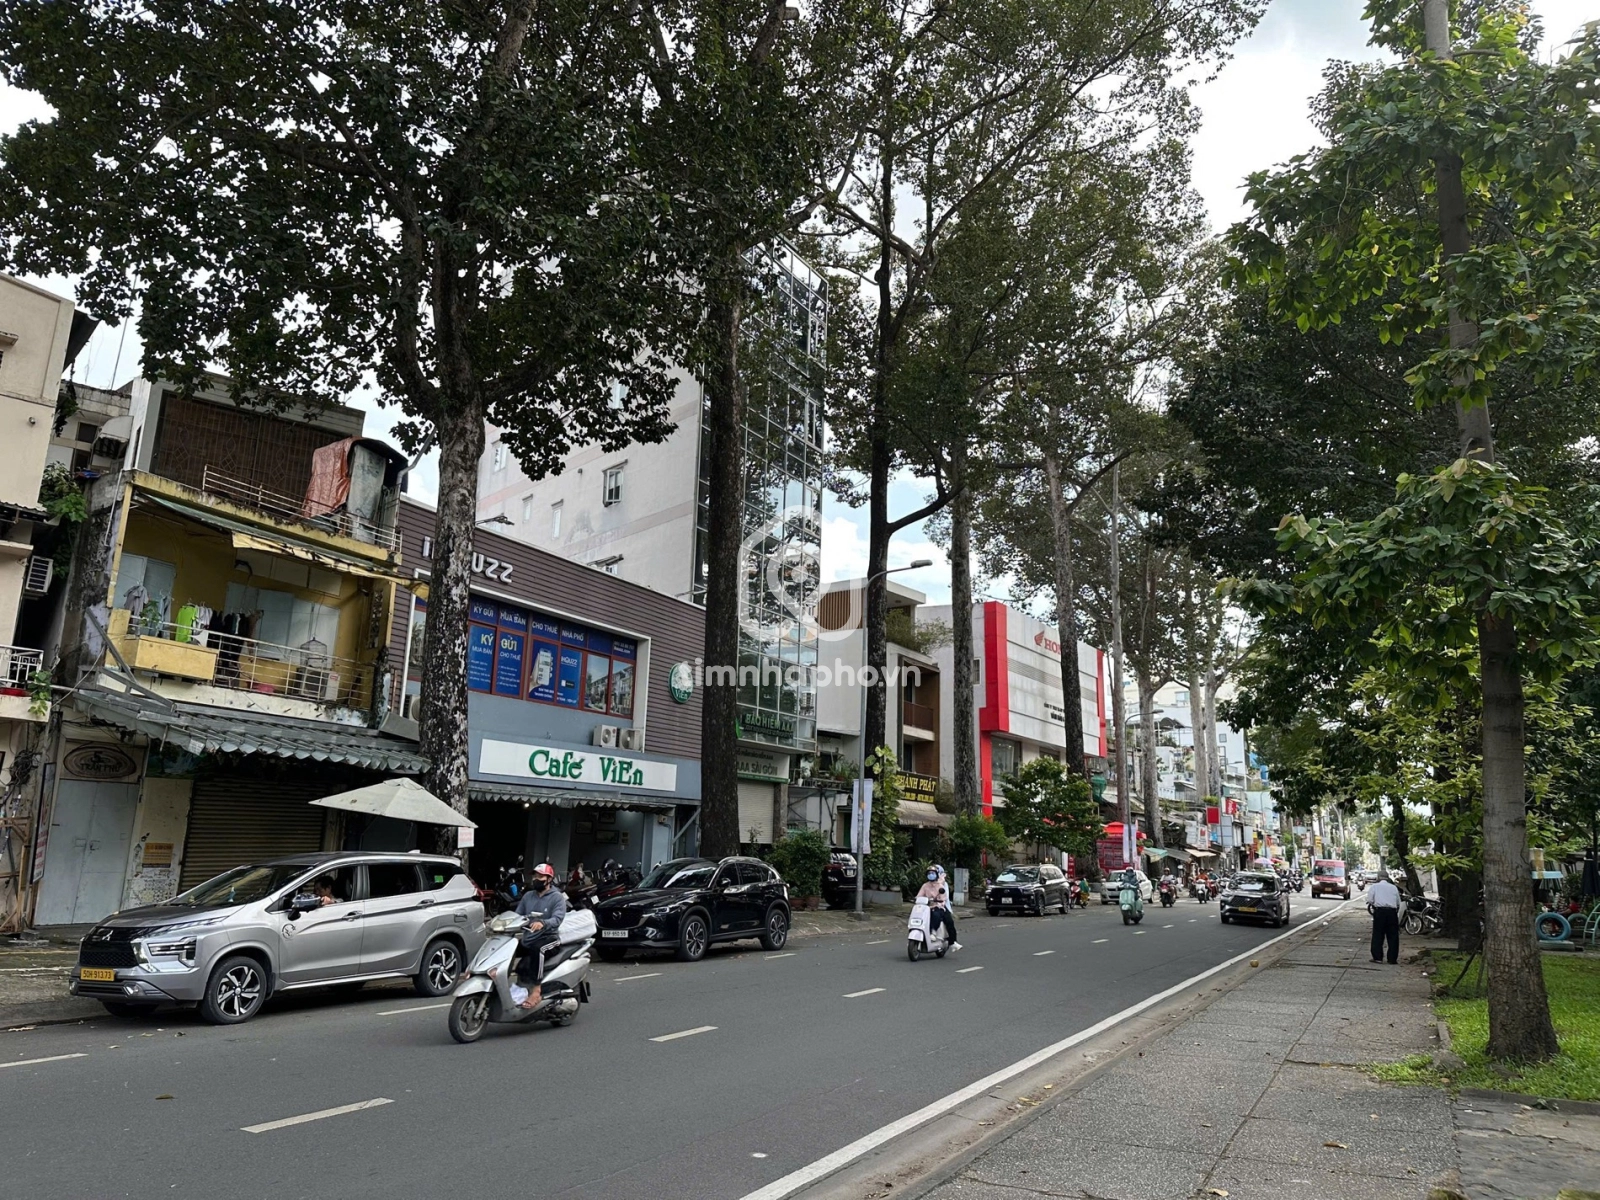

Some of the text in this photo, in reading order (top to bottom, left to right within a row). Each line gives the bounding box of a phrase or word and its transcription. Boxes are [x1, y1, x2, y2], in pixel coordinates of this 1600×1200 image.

[422, 536, 513, 583] iUZZ
[531, 621, 543, 631] CHO
[481, 633, 494, 646] KÝ
[1044, 638, 1061, 655] HO
[472, 645, 482, 653] MUA
[499, 651, 509, 659] CHO
[529, 749, 585, 779] Café
[918, 777, 936, 792] PHÁT
